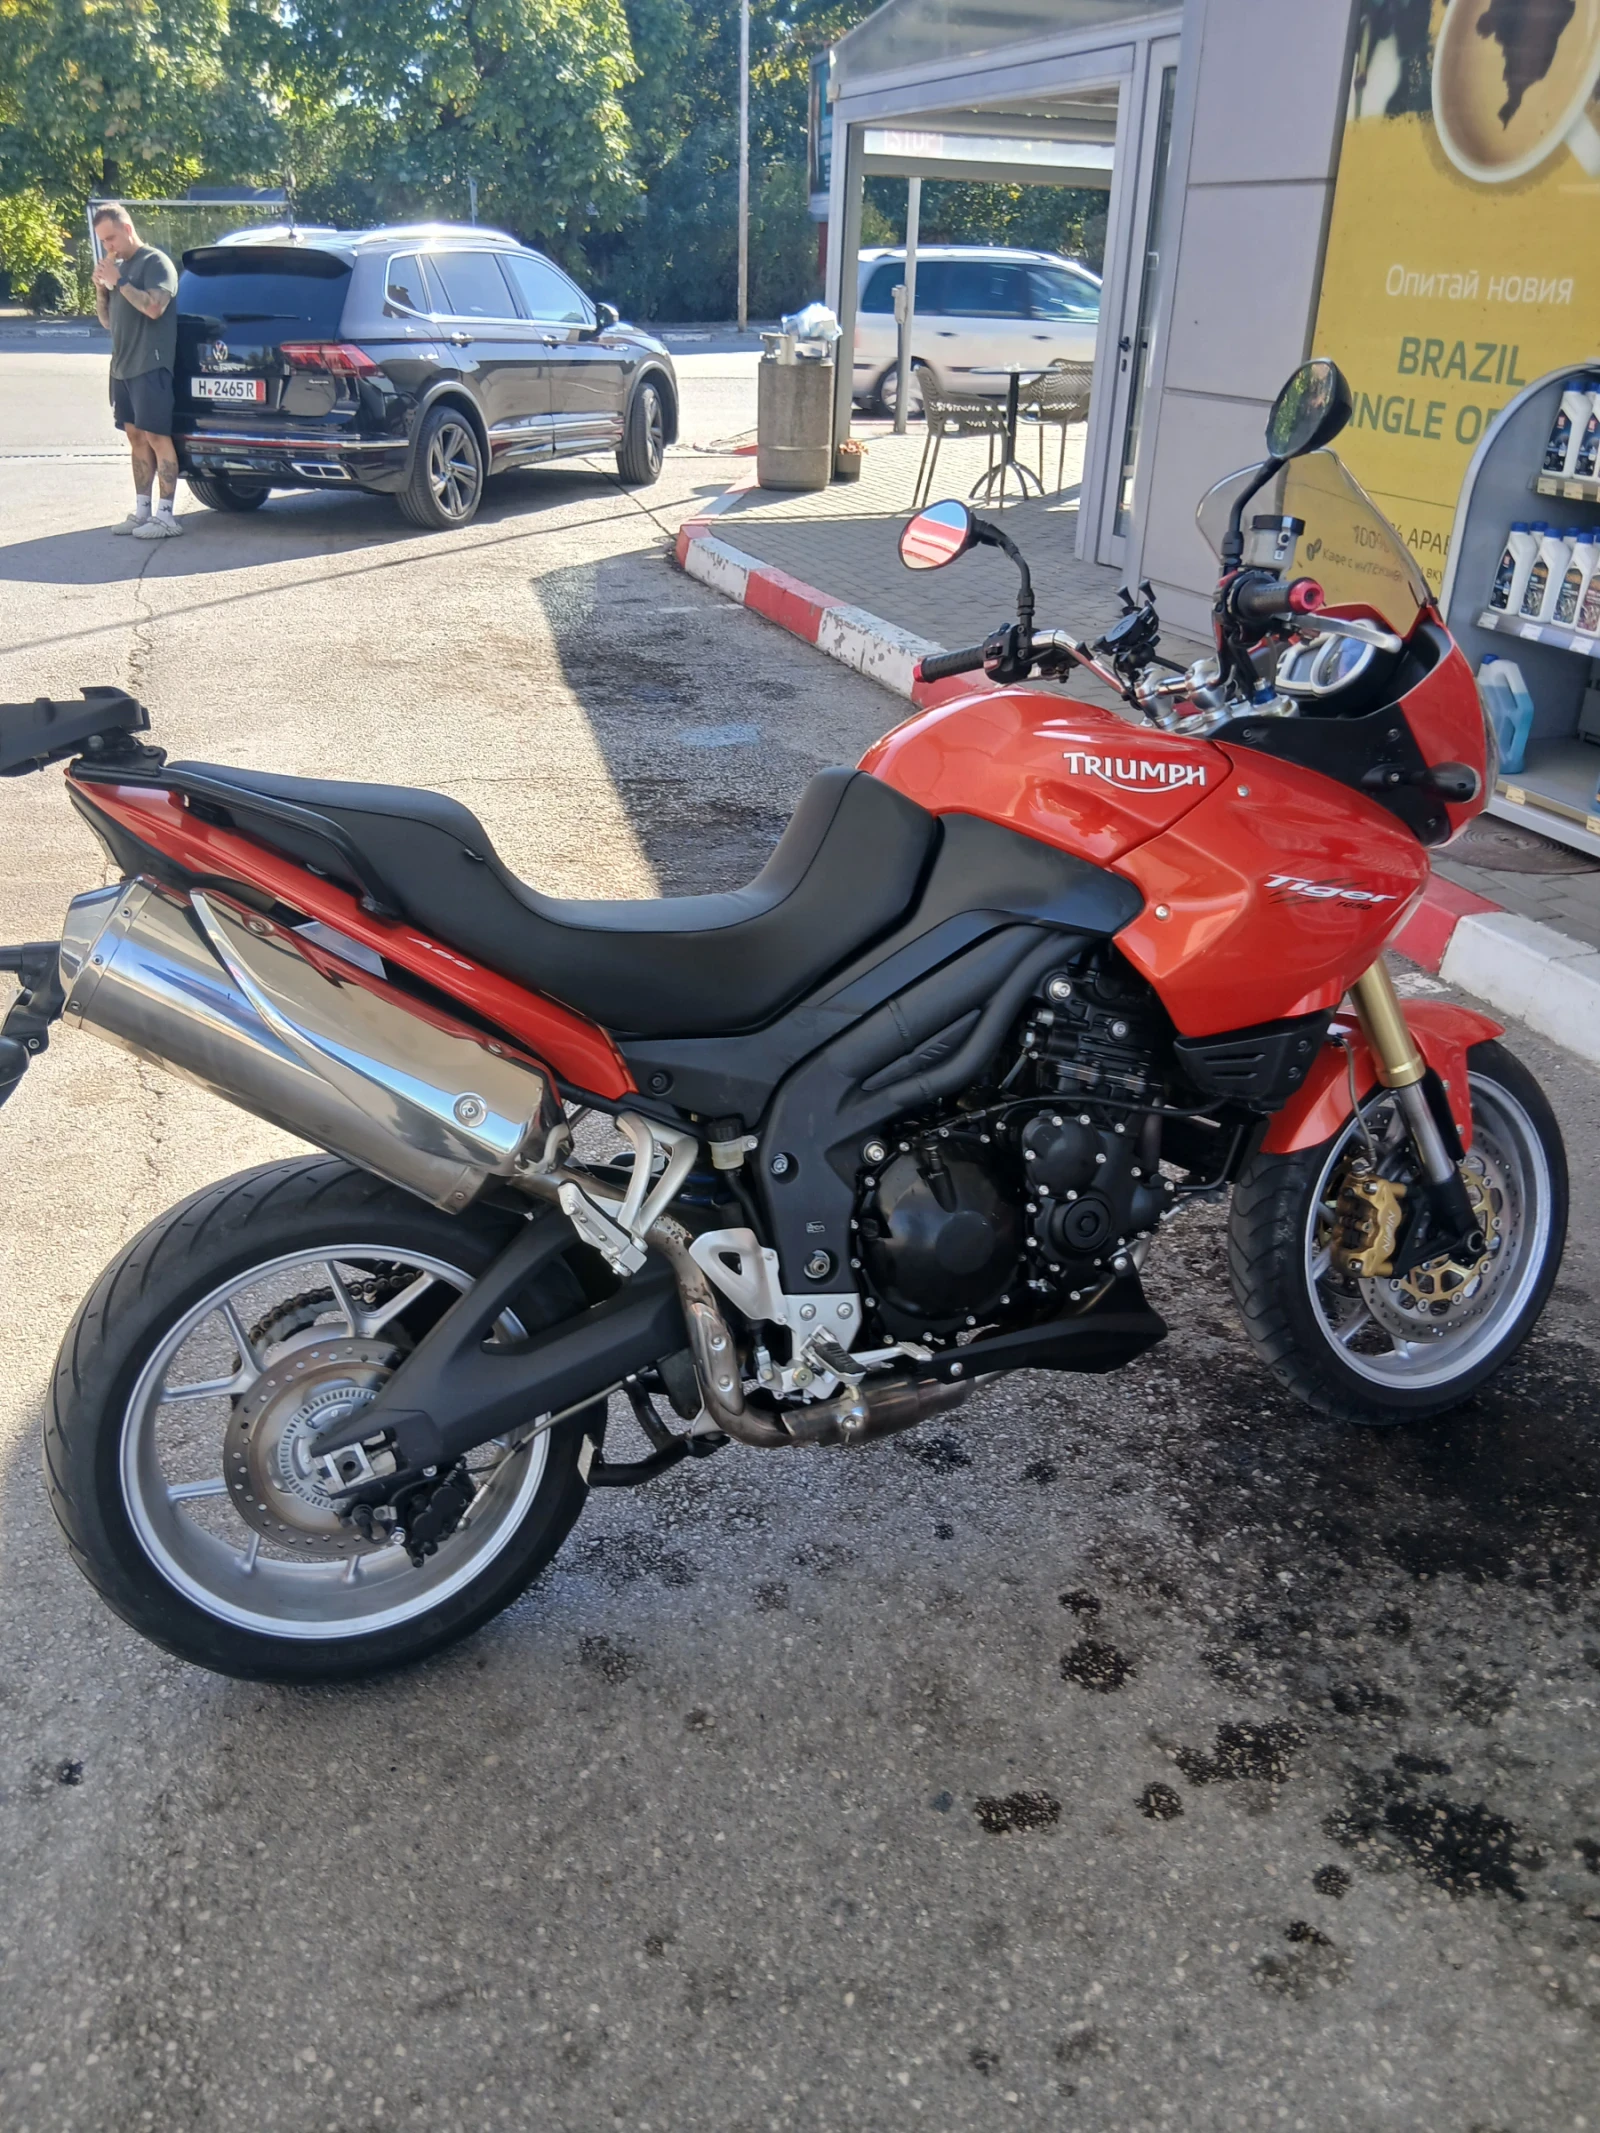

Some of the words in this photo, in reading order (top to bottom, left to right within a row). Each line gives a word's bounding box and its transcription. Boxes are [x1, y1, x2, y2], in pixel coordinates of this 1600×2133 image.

[1385, 264, 1480, 300] Опитай
[1487, 276, 1574, 305] новия
[1397, 336, 1526, 387] BRAZIL
[1348, 391, 1447, 440] INGLE
[1063, 752, 1206, 793] TRIUMPH
[1263, 874, 1398, 903] Tiger
